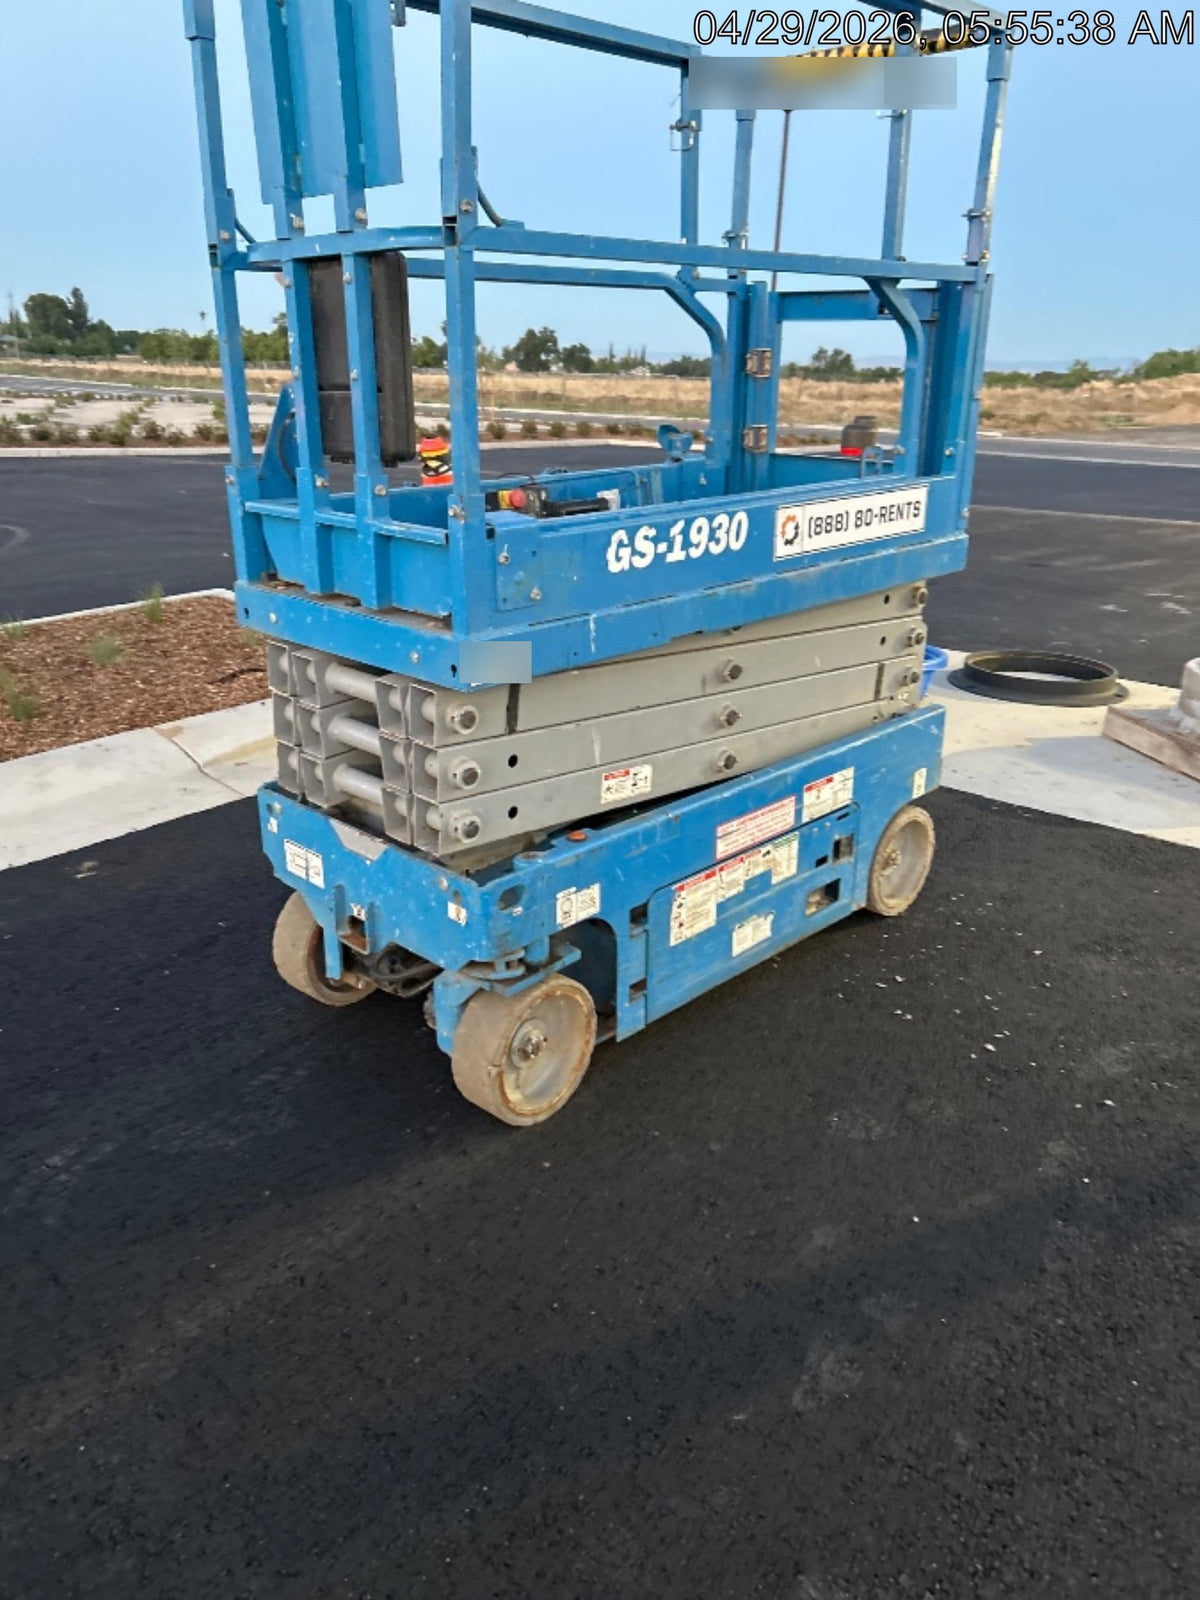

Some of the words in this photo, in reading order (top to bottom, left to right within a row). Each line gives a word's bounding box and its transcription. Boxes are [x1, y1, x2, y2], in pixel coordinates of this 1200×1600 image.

[606, 511, 749, 573] GS-1930
[807, 510, 850, 538] (888)
[854, 500, 922, 530] 80-RENTS
